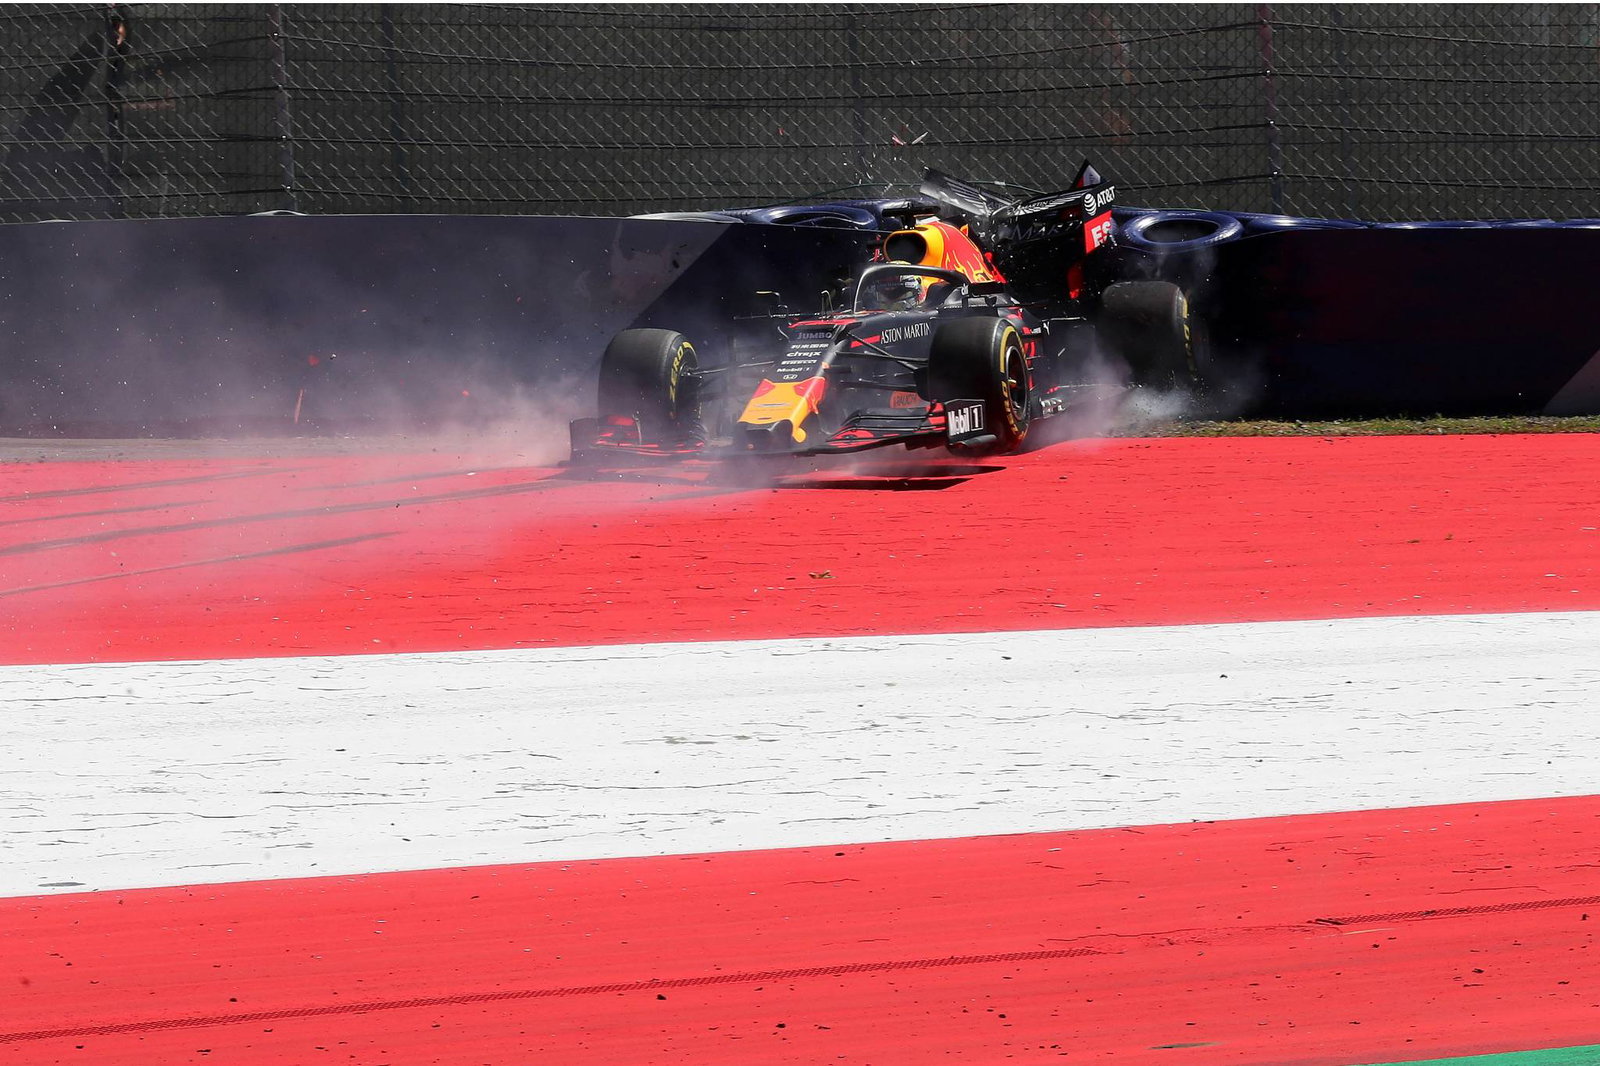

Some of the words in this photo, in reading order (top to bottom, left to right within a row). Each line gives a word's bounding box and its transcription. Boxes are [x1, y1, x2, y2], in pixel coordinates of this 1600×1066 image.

[1096, 185, 1116, 208] AT&T
[797, 332, 833, 340] JUMBO
[880, 327, 902, 345] ASTON
[904, 322, 930, 340] MARTIN
[669, 345, 684, 403] ZERO
[947, 406, 971, 437] Mobil
